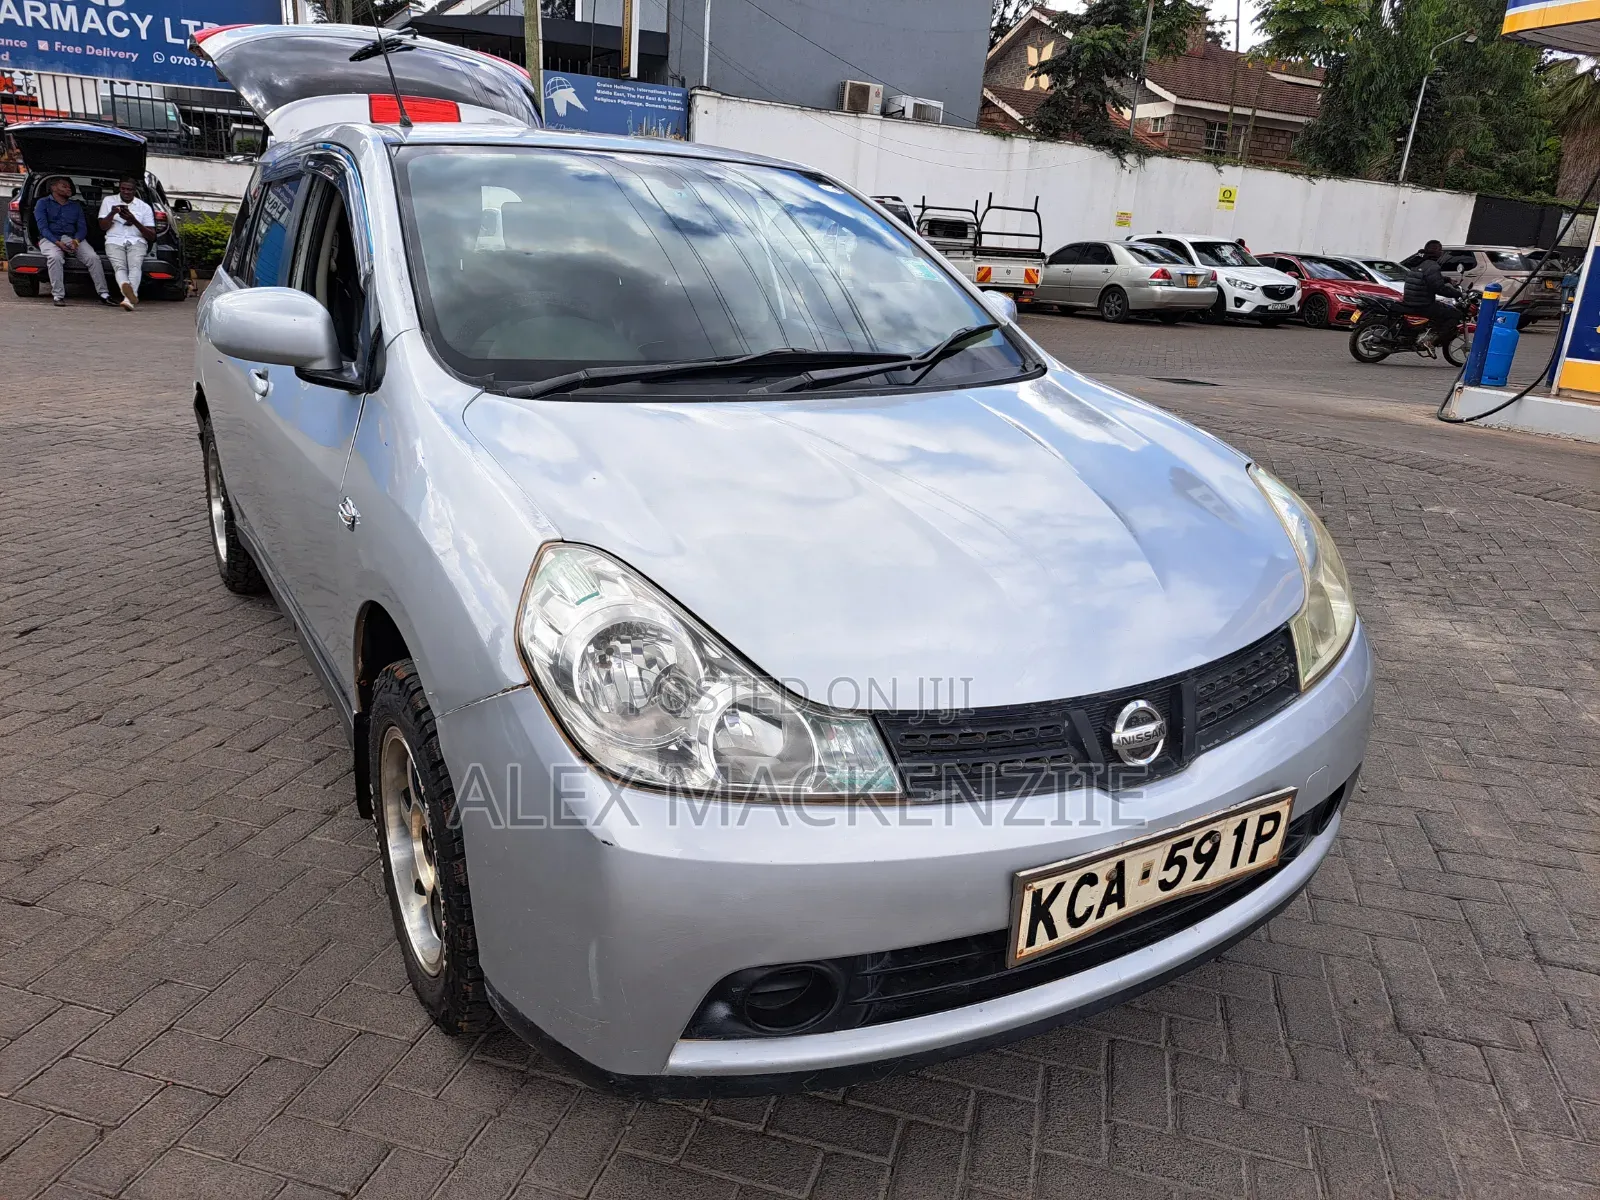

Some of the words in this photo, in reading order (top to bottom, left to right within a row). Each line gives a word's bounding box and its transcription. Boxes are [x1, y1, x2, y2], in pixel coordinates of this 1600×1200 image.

[54, 41, 82, 54] Free
[86, 44, 139, 62] Delivery
[169, 55, 198, 67] 0703
[594, 96, 617, 104] Religious
[618, 99, 645, 107] Pilgrimage,
[636, 87, 667, 95] International
[1120, 723, 1165, 746] NISSAN
[1025, 859, 1127, 949] KCA
[1157, 810, 1282, 892] 591P
